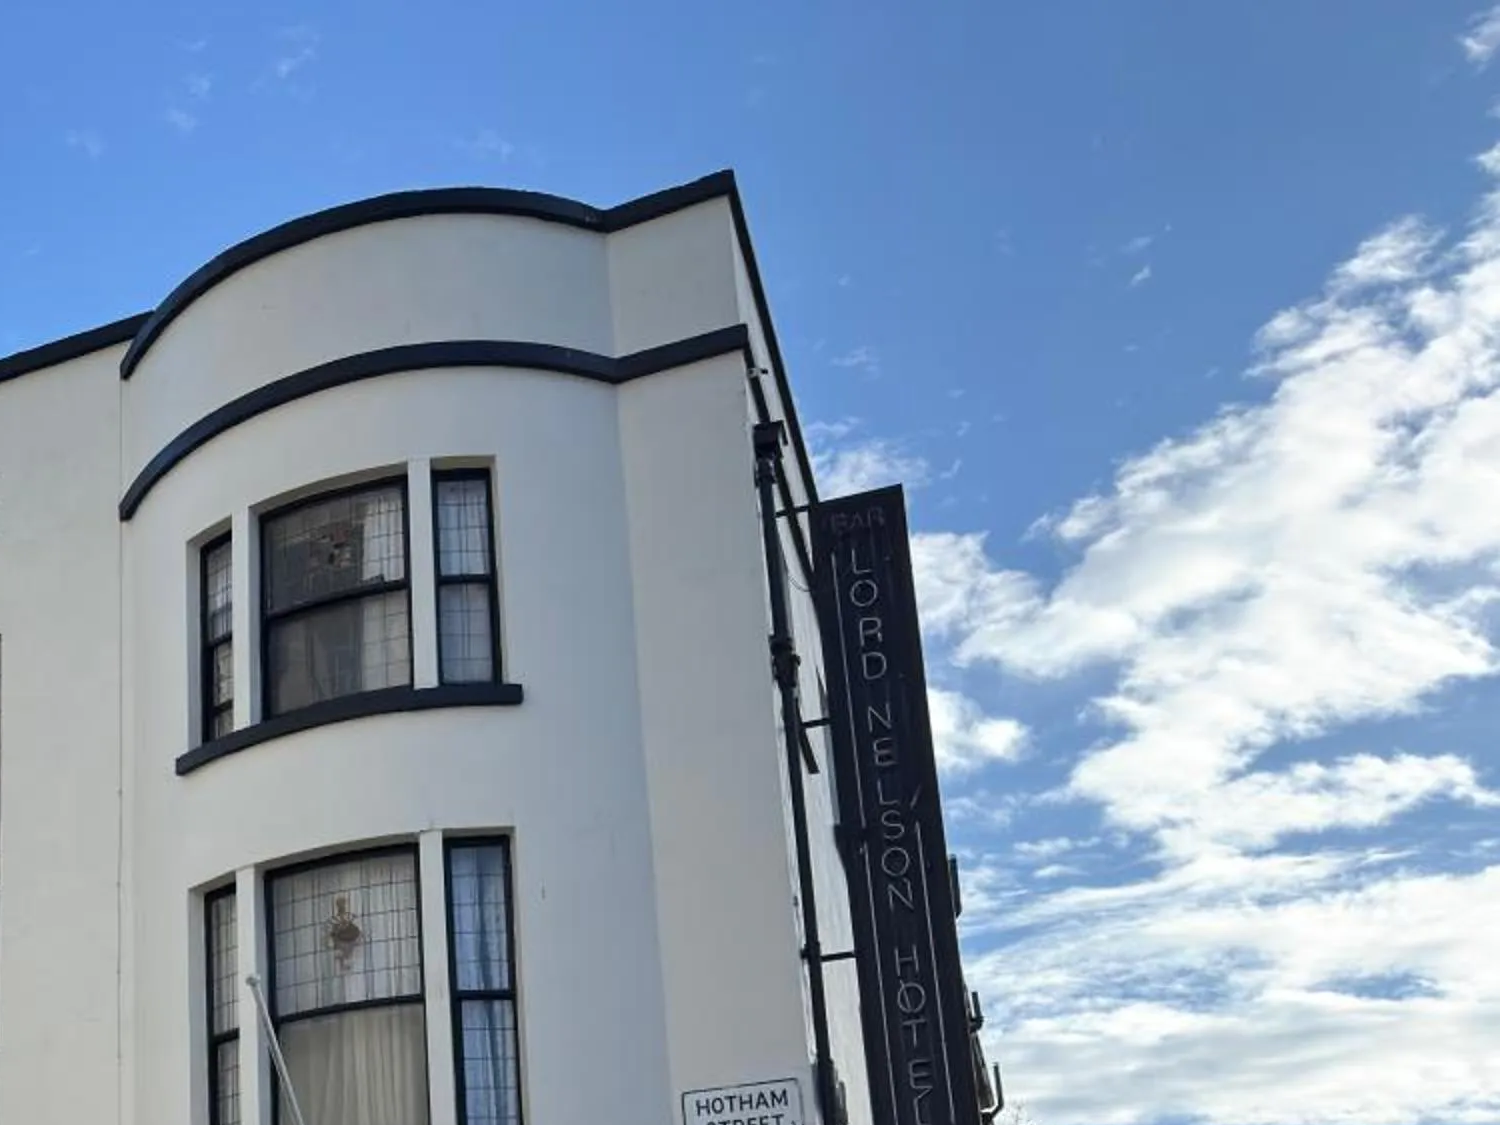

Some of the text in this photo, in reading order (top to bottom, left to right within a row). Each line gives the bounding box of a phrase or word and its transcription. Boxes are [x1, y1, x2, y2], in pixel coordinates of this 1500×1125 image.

[851, 548, 888, 680] LORD
[867, 702, 915, 913] NELSON
[695, 1087, 789, 1117] HOTHAM
